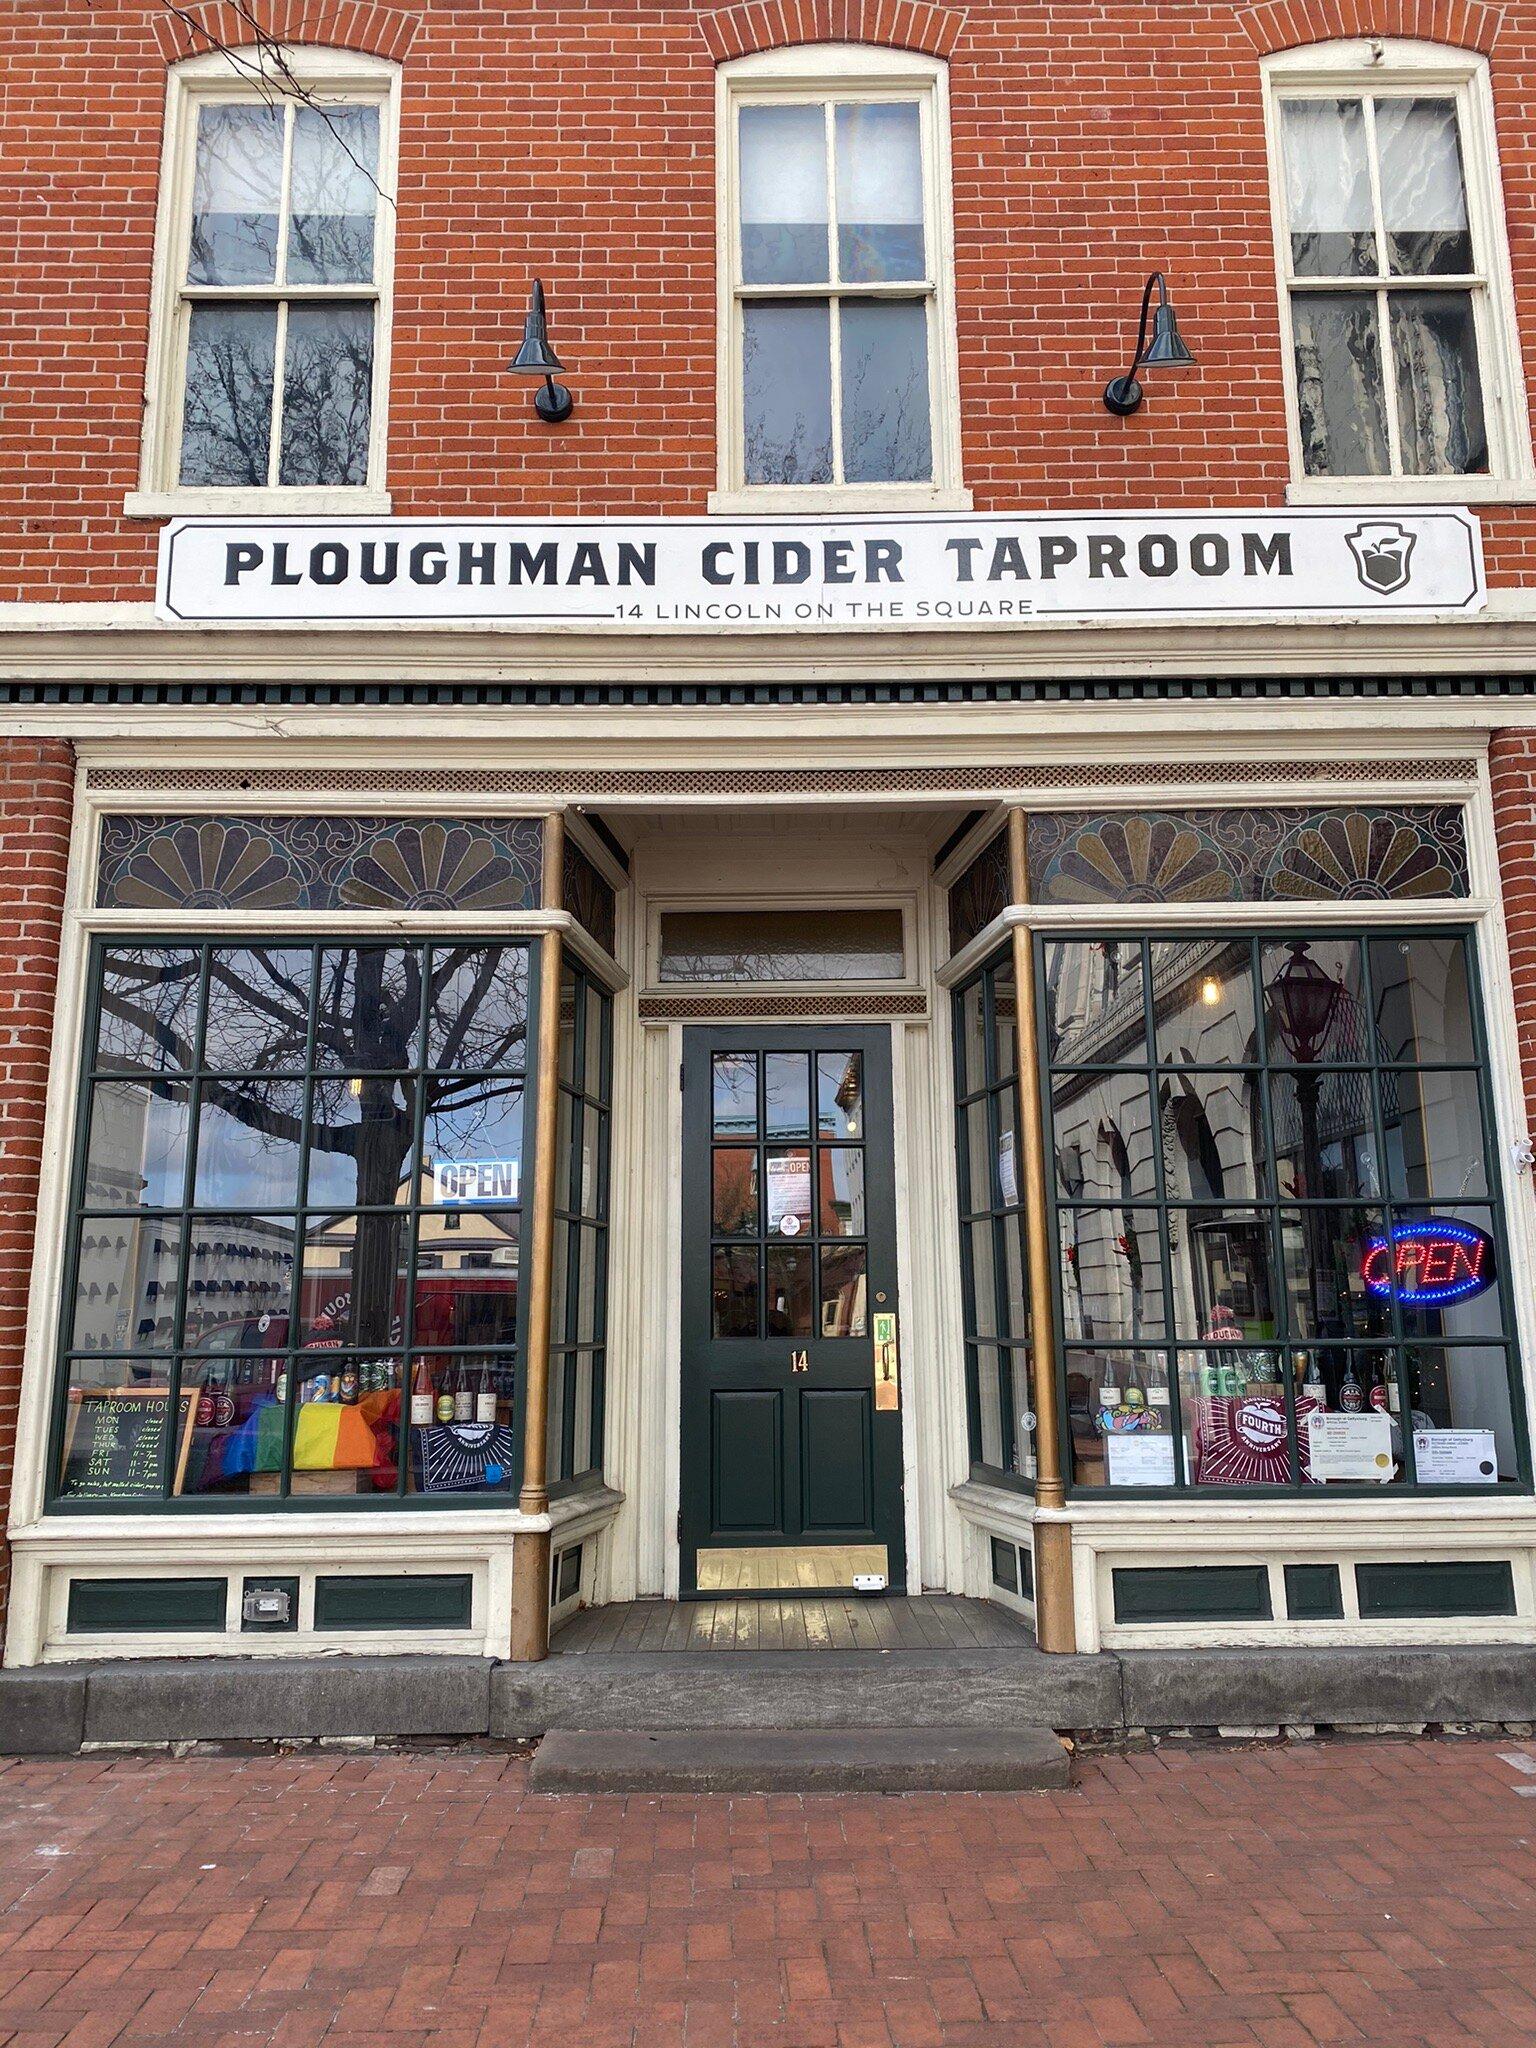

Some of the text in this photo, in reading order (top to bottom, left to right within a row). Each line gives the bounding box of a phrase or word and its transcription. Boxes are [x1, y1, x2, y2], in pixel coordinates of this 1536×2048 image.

[225, 533, 1293, 585] PLOUGHMAN CIDER TAPROOM
[616, 600, 1033, 619] 14 LINCOLN ON THE SQUARE
[441, 1164, 512, 1197] OPEN
[1363, 1240, 1484, 1284] OPEN
[791, 1350, 808, 1372] 14
[85, 1400, 189, 1413] TAPROOM HOS
[94, 1416, 119, 1425] MON
[1242, 1414, 1282, 1435] FOURTH
[94, 1426, 120, 1434] TUES
[92, 1441, 116, 1449] THUR
[457, 1433, 491, 1449] ANNIVERSARY
[1241, 1436, 1282, 1452] ANNIVERSARY
[91, 1449, 110, 1457] FRI
[88, 1458, 112, 1467] SAT
[87, 1467, 110, 1476] SUN
